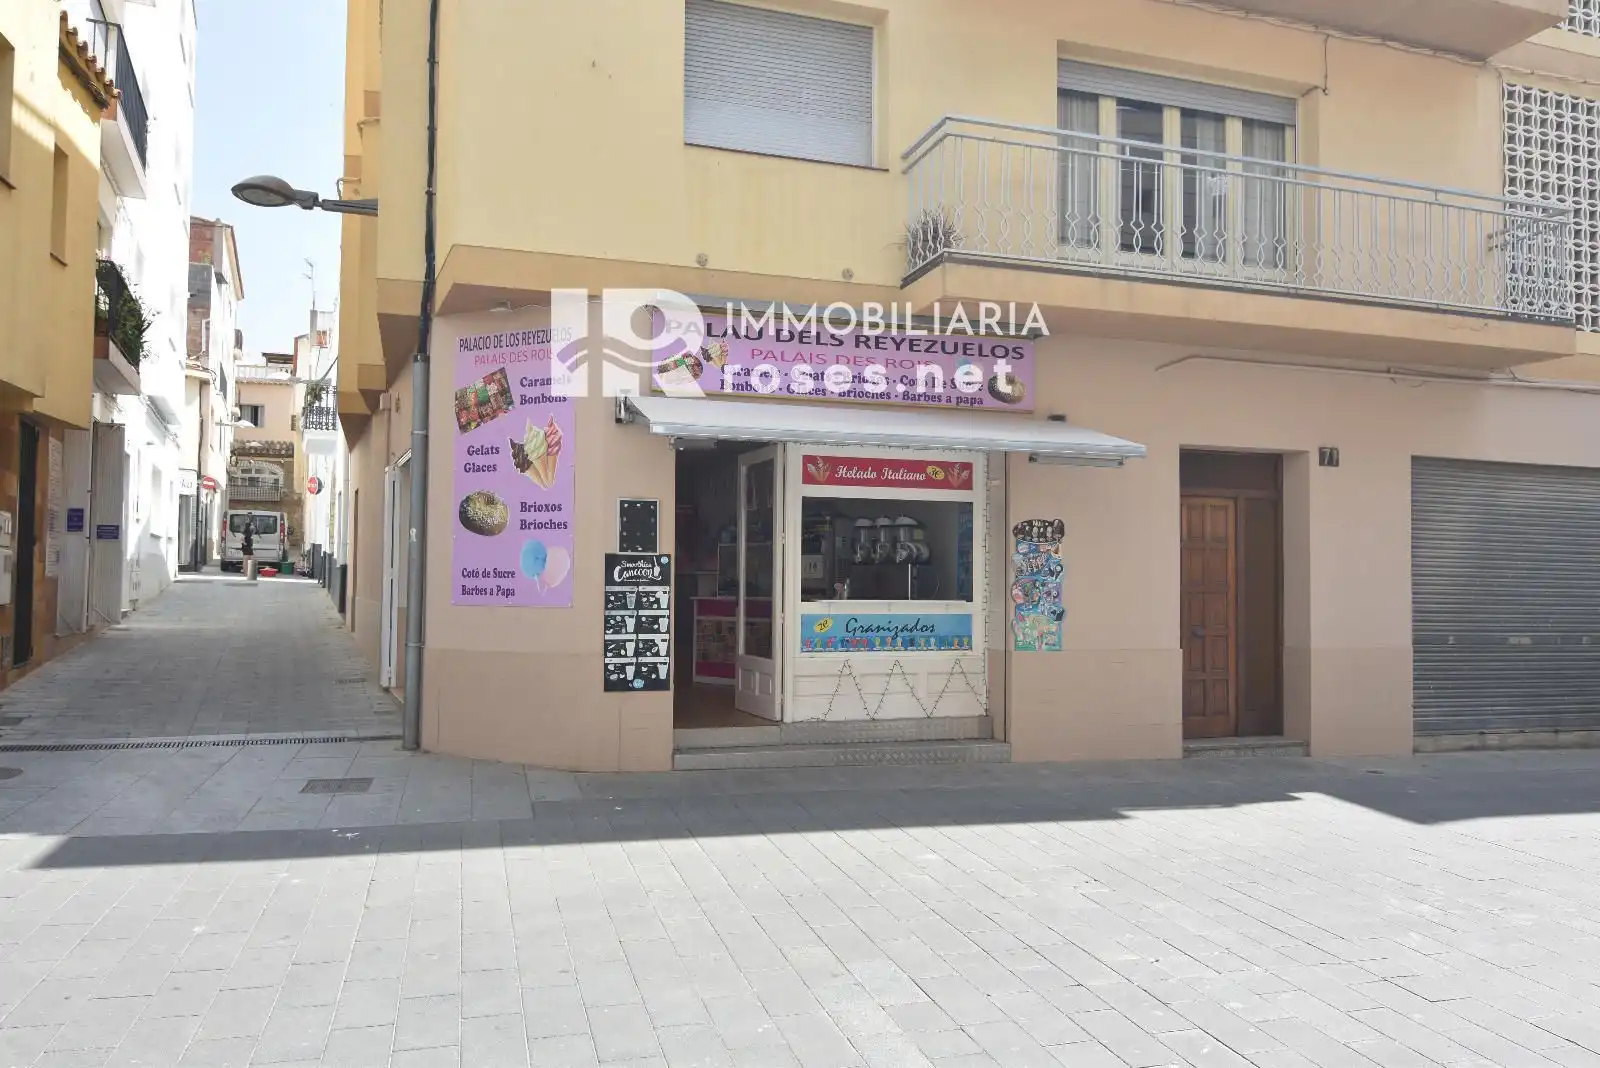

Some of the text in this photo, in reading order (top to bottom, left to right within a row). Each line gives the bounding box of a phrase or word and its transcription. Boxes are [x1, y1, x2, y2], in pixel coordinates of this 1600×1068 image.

[459, 327, 572, 352] PALACIO DE LOS REYEZUELOS
[665, 320, 1025, 360] PALAU DELS REYEZUELOS
[474, 352, 507, 367] PALAIS
[509, 349, 528, 362] DES
[751, 348, 831, 365] PALAIS
[835, 354, 876, 367] DES
[519, 393, 567, 405] Bonbons
[903, 390, 942, 403] Barbes
[956, 396, 983, 407] papa
[467, 444, 500, 457] Gelats
[1321, 448, 1337, 465] 71
[464, 461, 497, 473] Glaces
[835, 465, 926, 480] Helado Italiano
[519, 501, 563, 513] Brioxos
[519, 518, 568, 530] Brioches
[482, 567, 491, 579] de
[492, 567, 516, 579] Sucre
[461, 584, 516, 598] Barbes a Papa
[845, 617, 936, 640] Granizados
